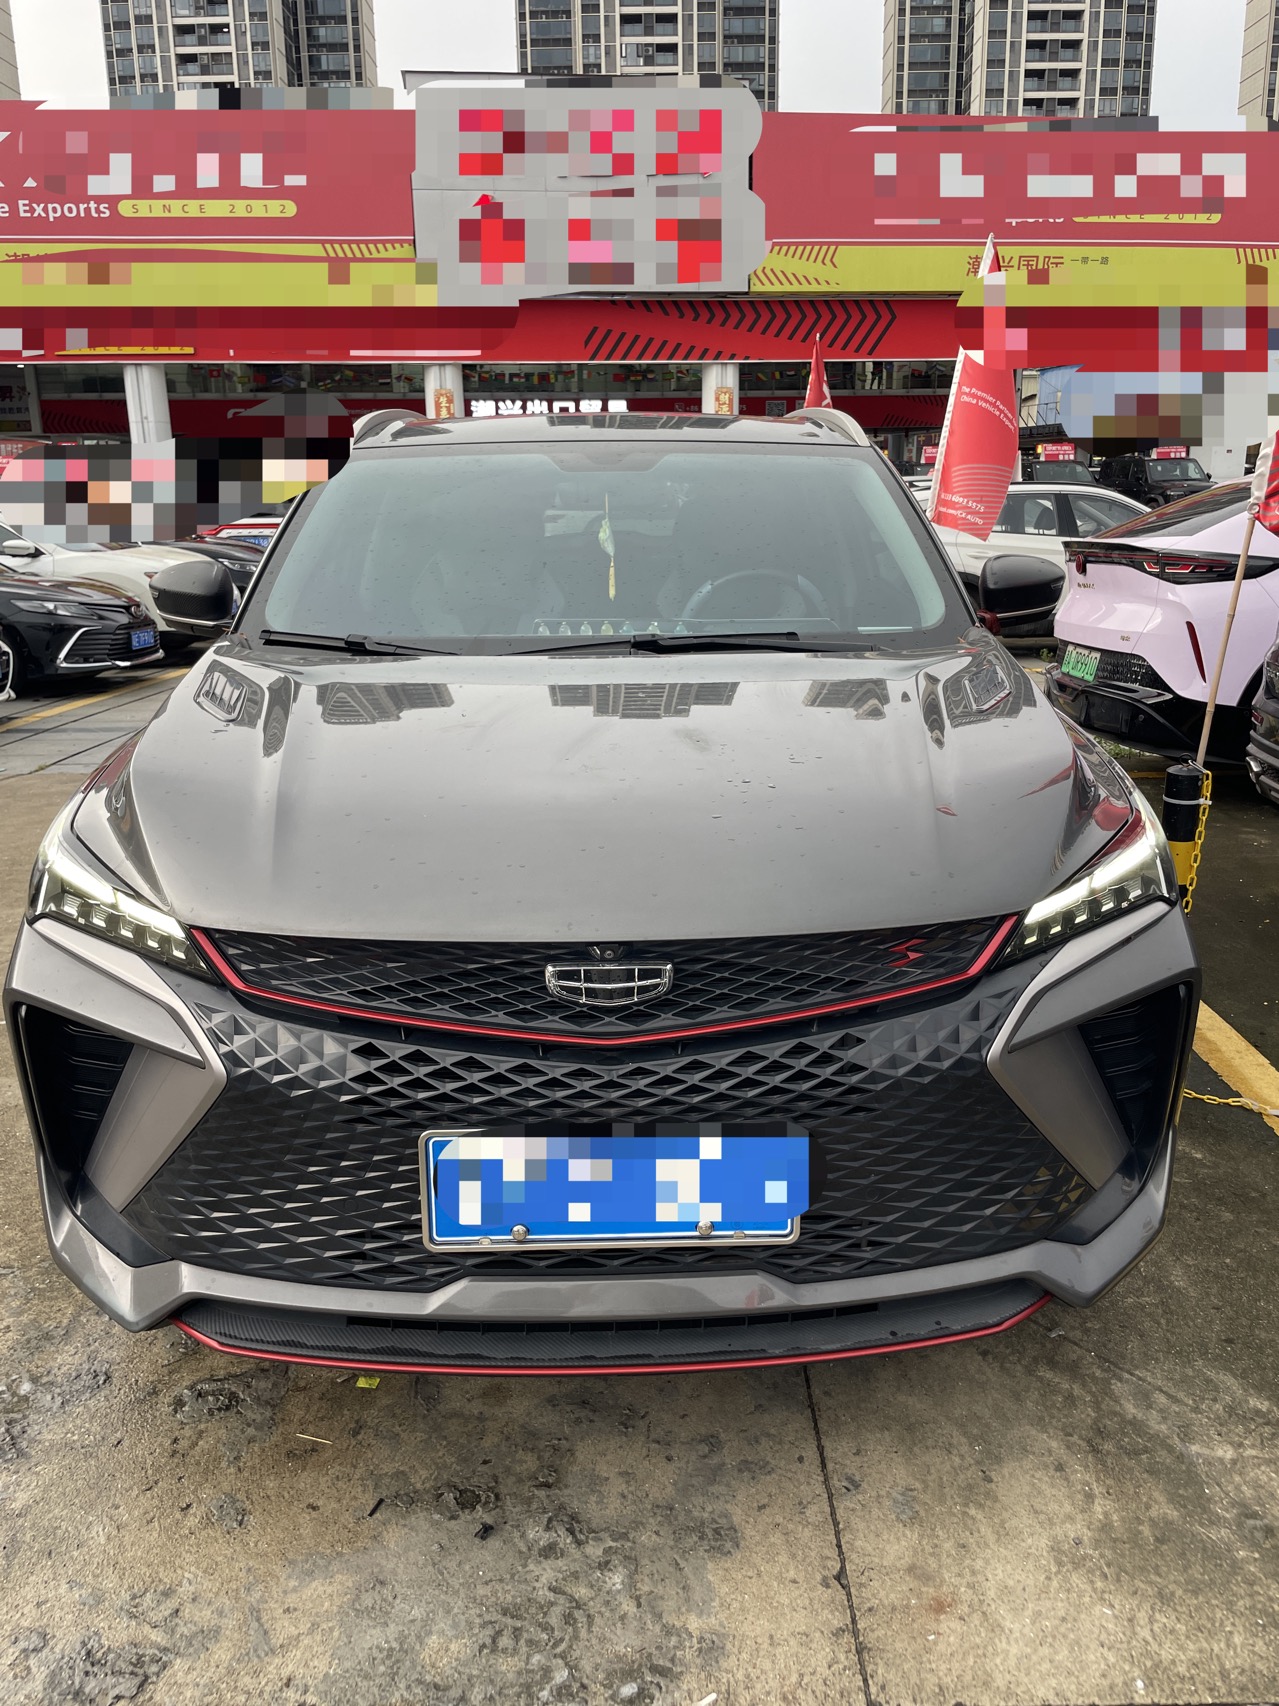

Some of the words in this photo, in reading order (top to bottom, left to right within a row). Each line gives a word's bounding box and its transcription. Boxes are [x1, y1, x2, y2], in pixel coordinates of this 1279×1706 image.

[18, 200, 110, 221] Exports
[131, 204, 206, 213] SINCE
[229, 204, 287, 213] 2012
[1070, 256, 1110, 265] 一带一路
[961, 395, 976, 404] China
[978, 399, 1000, 416] Vehicle
[971, 388, 996, 403] Premier
[996, 401, 1013, 419] Partner
[952, 495, 967, 505] 6093
[967, 500, 985, 512] 5575
